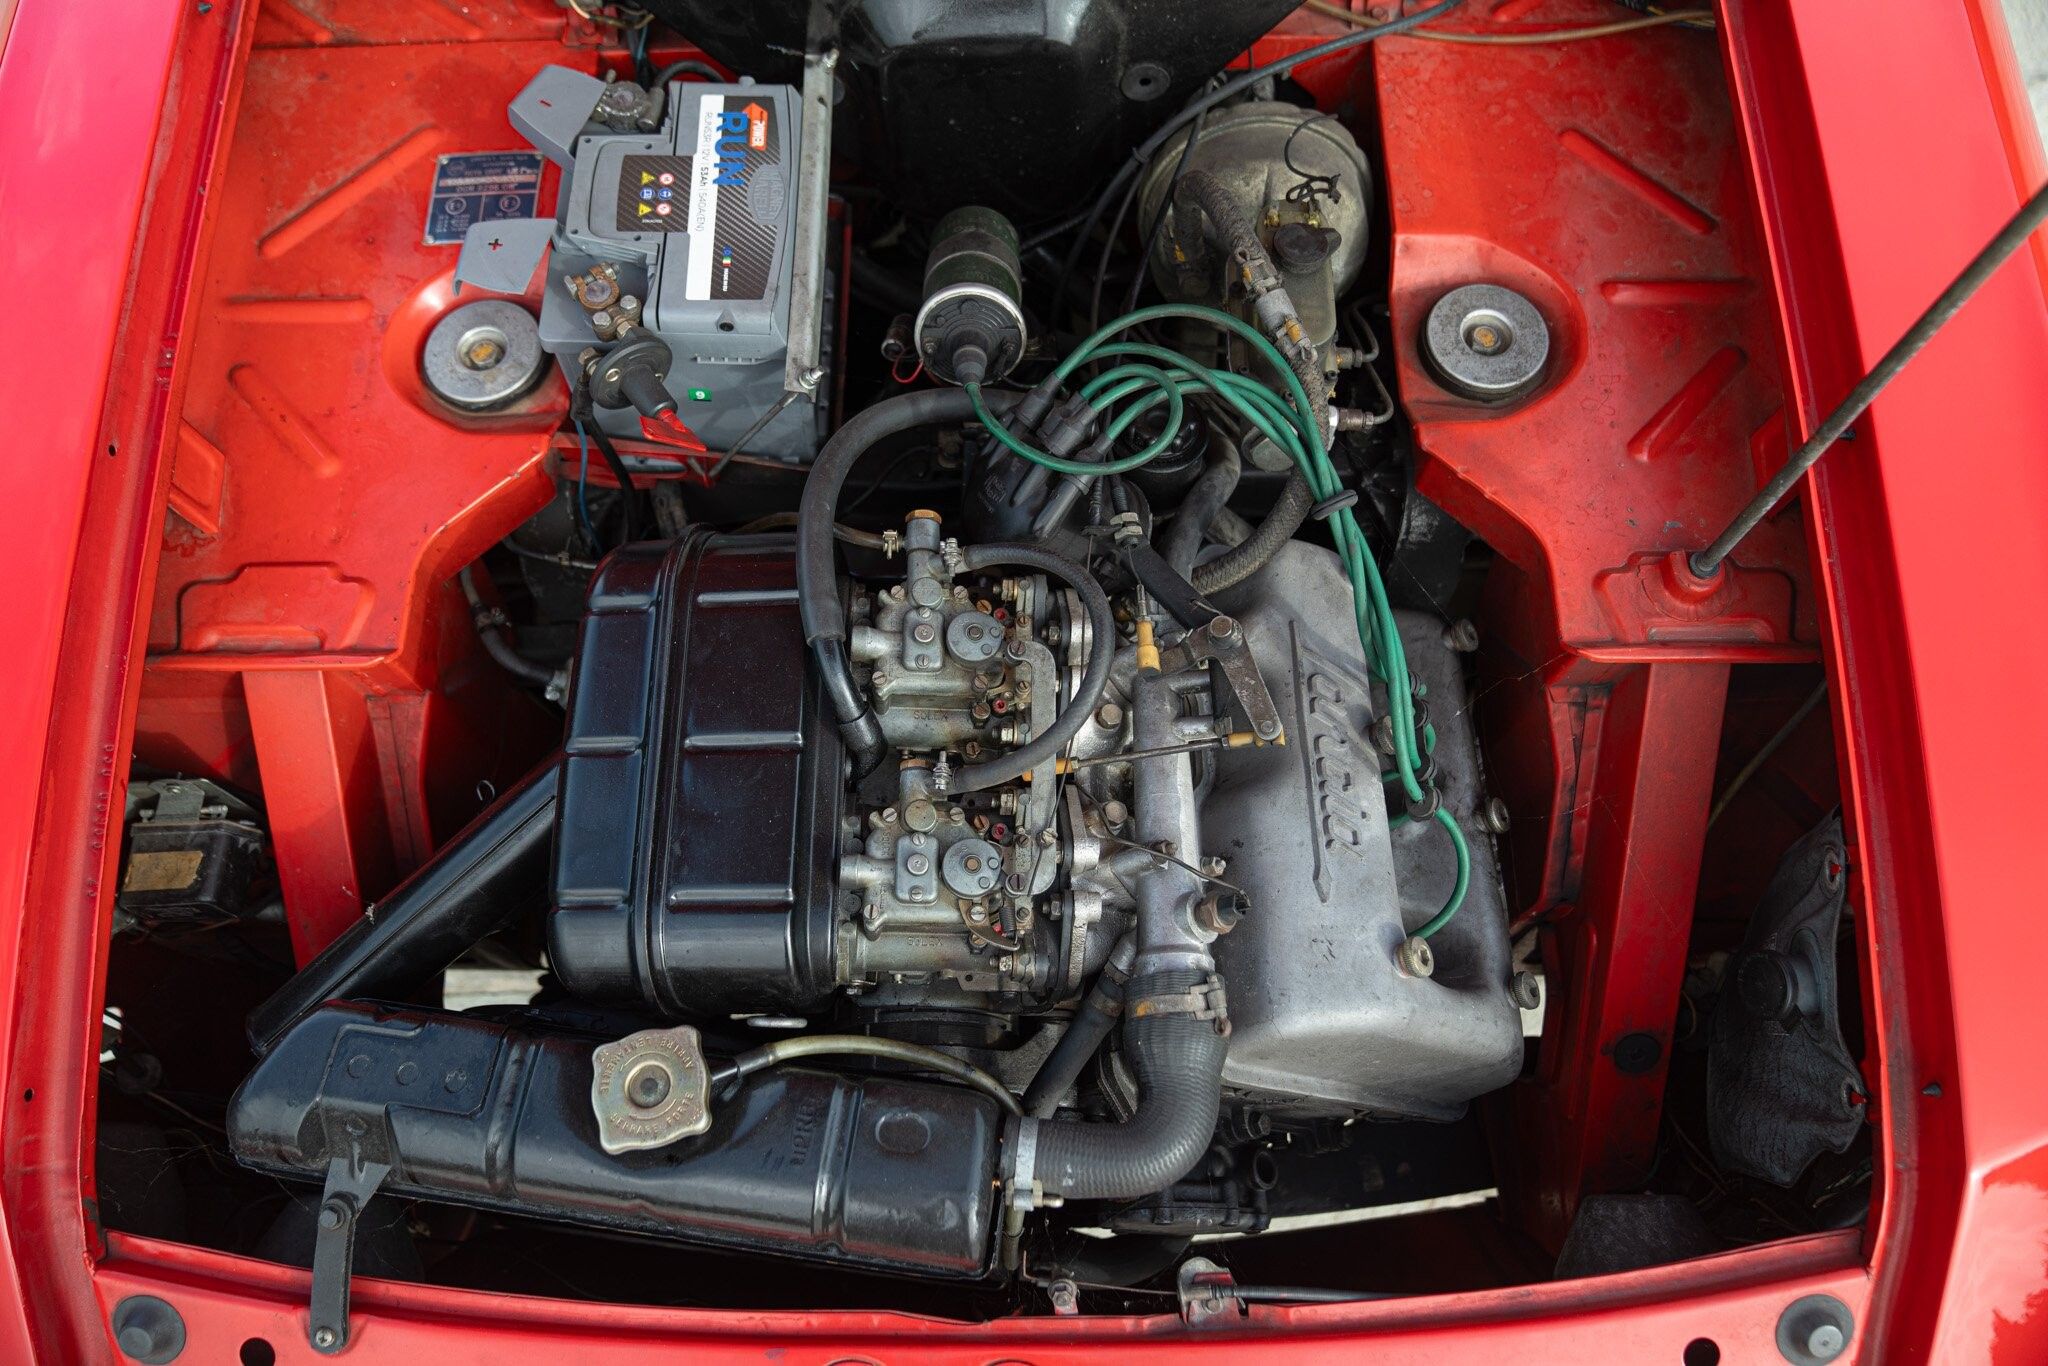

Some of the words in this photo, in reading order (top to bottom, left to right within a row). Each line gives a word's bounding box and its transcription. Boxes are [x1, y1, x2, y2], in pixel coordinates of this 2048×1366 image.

[750, 119, 766, 148] POWER
[712, 111, 748, 186] RUN
[699, 167, 710, 188] 53Ah
[906, 936, 944, 948] SOLEX
